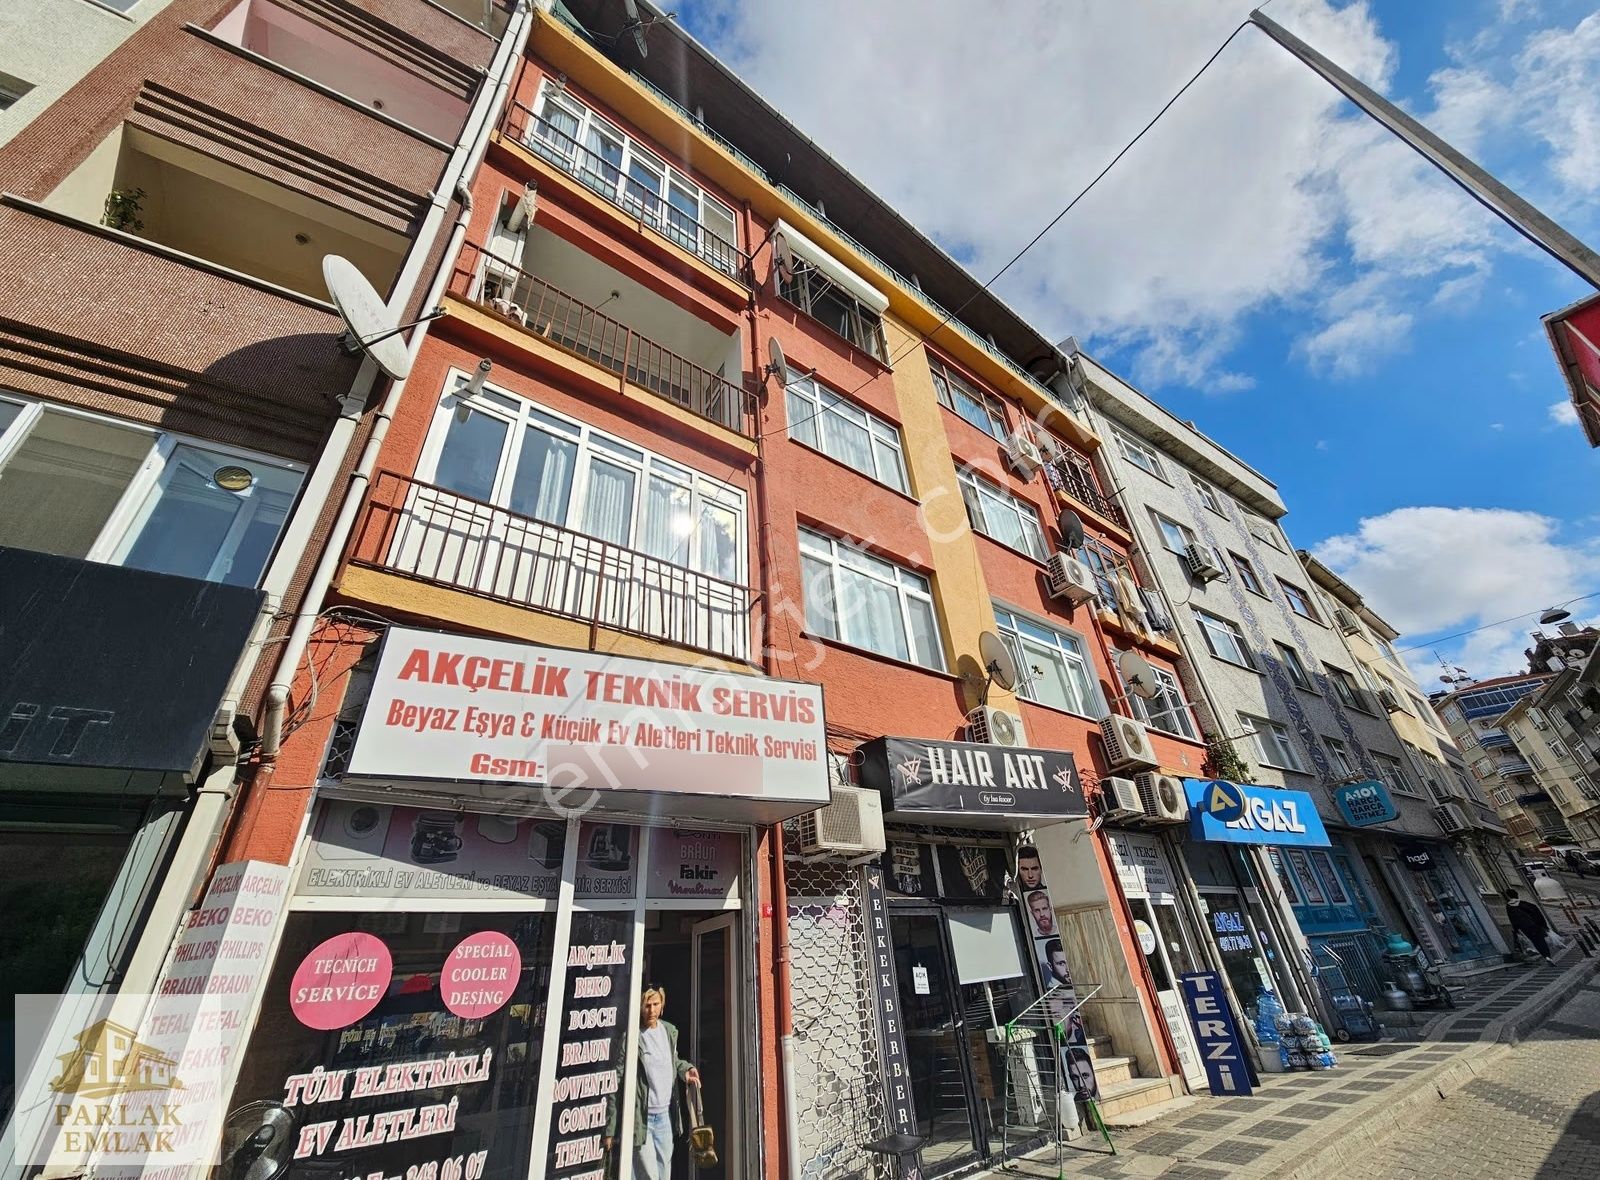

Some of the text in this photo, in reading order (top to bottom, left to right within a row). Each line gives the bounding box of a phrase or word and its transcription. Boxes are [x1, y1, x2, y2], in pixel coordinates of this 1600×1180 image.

[398, 649, 816, 724] AKÇELİK TEKNİK SERVİS
[386, 699, 817, 761] Beyaz Eşya & Küçük Ev Aletleri Teknik Servisi
[470, 753, 544, 777] Gsm:
[927, 746, 1048, 789] HAIR ART
[1350, 804, 1385, 815] HARCA
[681, 842, 717, 861] BRAUN
[1406, 852, 1430, 863] hadi
[307, 867, 393, 888] ELEKTRİKLİ
[394, 871, 413, 888] EV
[415, 871, 476, 890] ALETLERİ
[492, 875, 529, 891] BEYAZ
[593, 875, 631, 893] SERVİSİ
[680, 864, 718, 879] Fakir
[187, 907, 273, 928] BEKO BEKO
[175, 940, 264, 963] PHILLIPS PHILLIPS
[455, 942, 512, 959] SPECİAL
[567, 940, 626, 970] ARÇELİK
[160, 975, 253, 997] BRAUN BRAUN
[451, 967, 507, 982] COOLER
[295, 982, 380, 1003] SERVİCE
[450, 988, 503, 1005] DESİNG
[574, 976, 612, 998] BEKO
[150, 1010, 240, 1035] TEFAL TEFAL
[568, 1007, 617, 1030] BOSCH
[873, 899, 909, 1134] ERKEK BERBER
[1185, 976, 1237, 1090] TERZİ
[562, 1038, 611, 1067] BRAUN
[283, 1047, 493, 1107] TÜM ELEKTRİKLİ
[293, 1095, 458, 1160] EV ALETLERİ
[559, 1097, 607, 1134] CONTİ
[555, 1135, 604, 1169] TEFAL
[465, 1150, 488, 1180] 07
